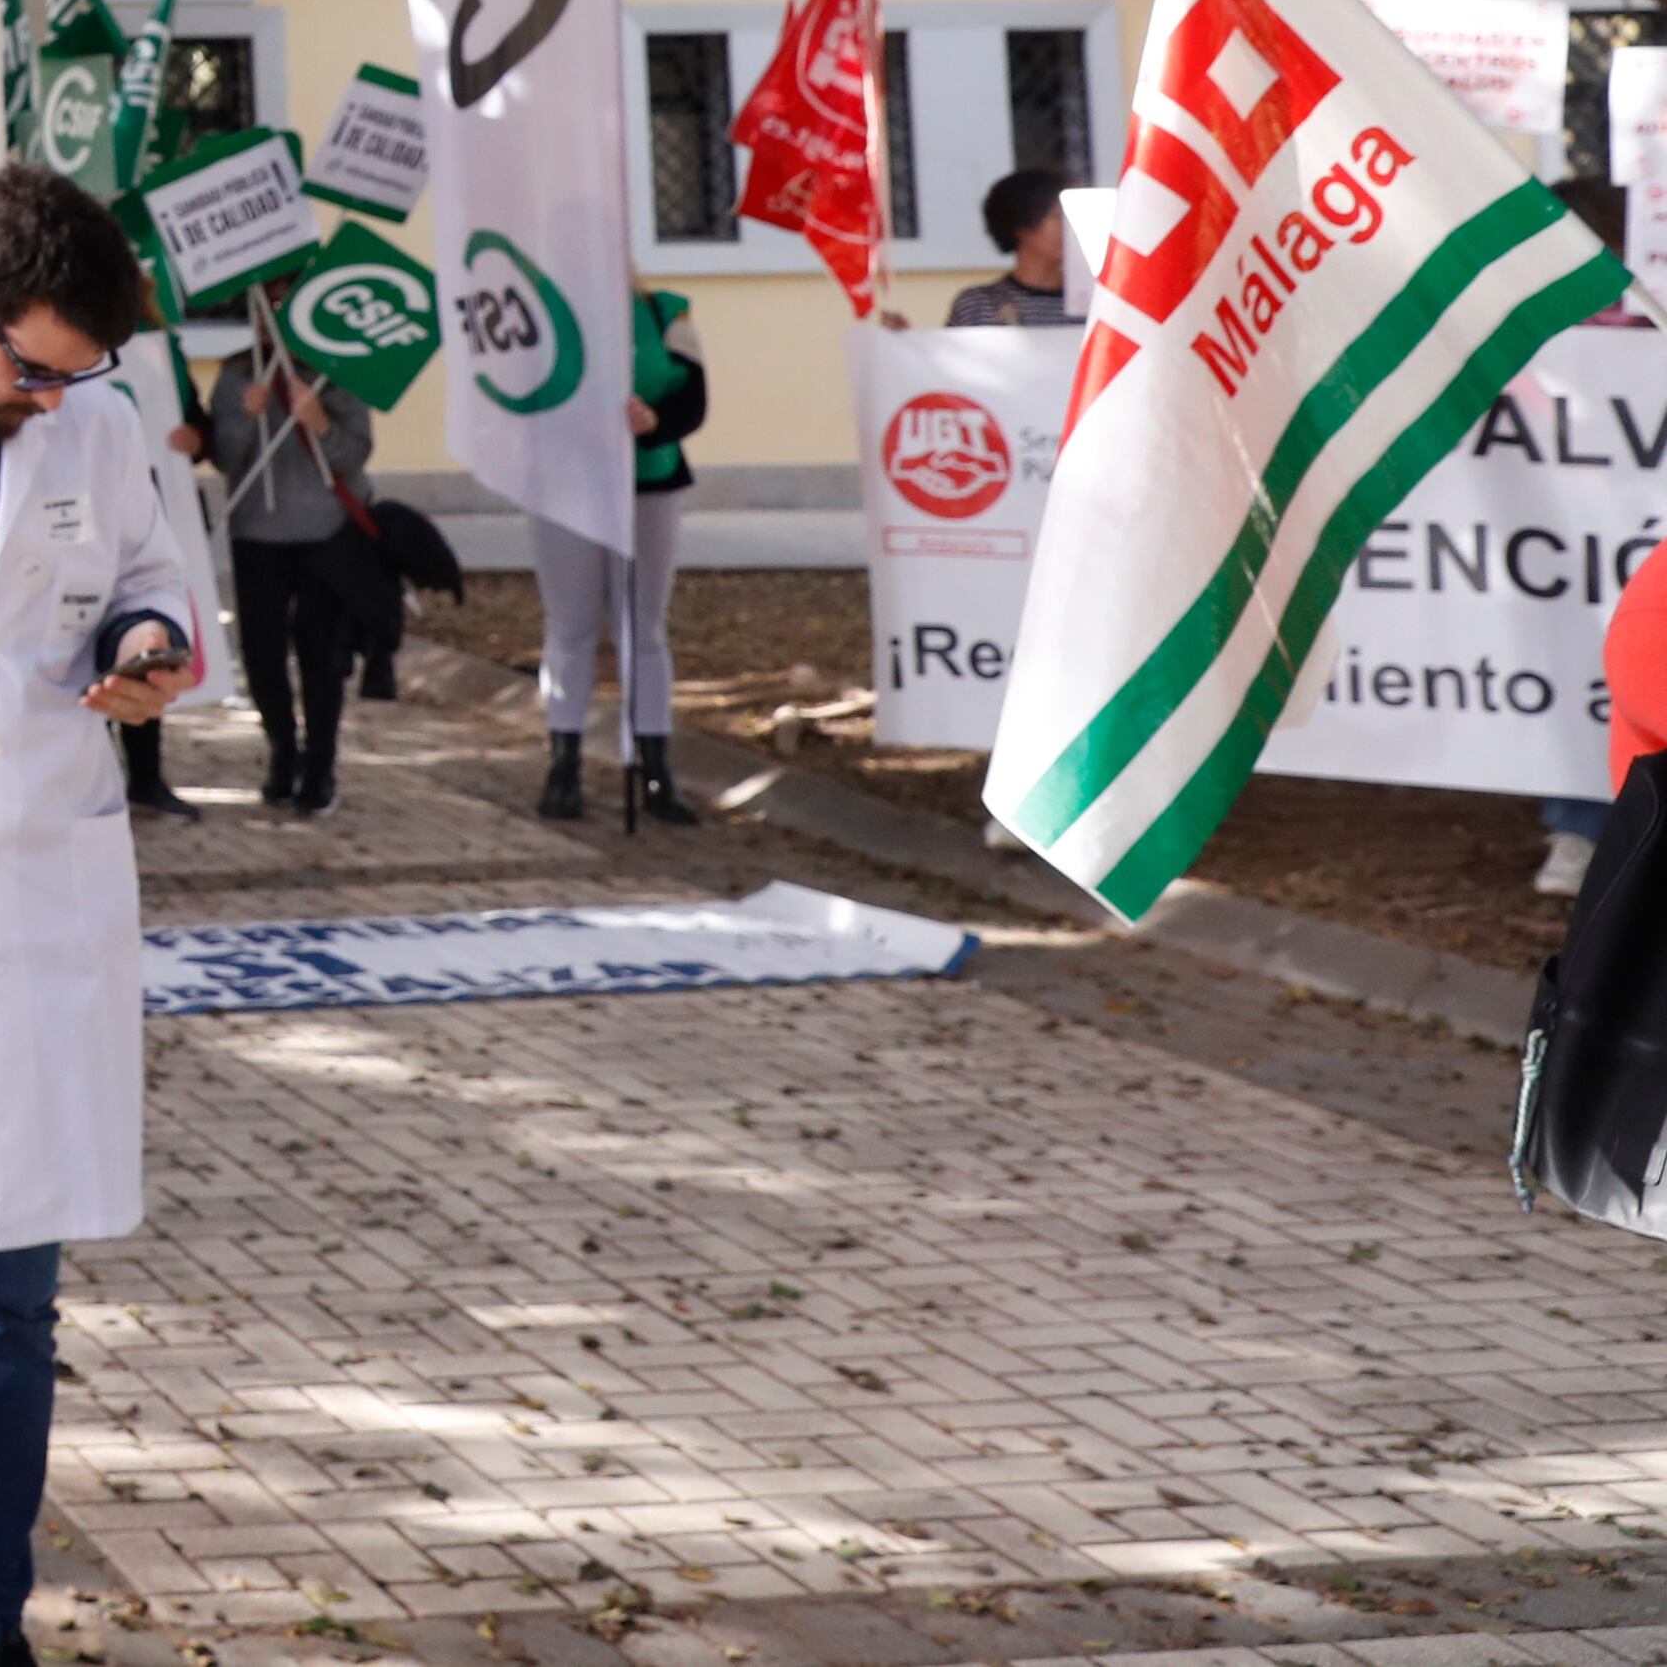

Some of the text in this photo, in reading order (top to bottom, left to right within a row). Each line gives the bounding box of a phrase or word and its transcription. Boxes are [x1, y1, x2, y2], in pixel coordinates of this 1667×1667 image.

[1190, 127, 1417, 400] Málaga
[323, 284, 430, 348] CSIF
[898, 408, 987, 456] UGT
